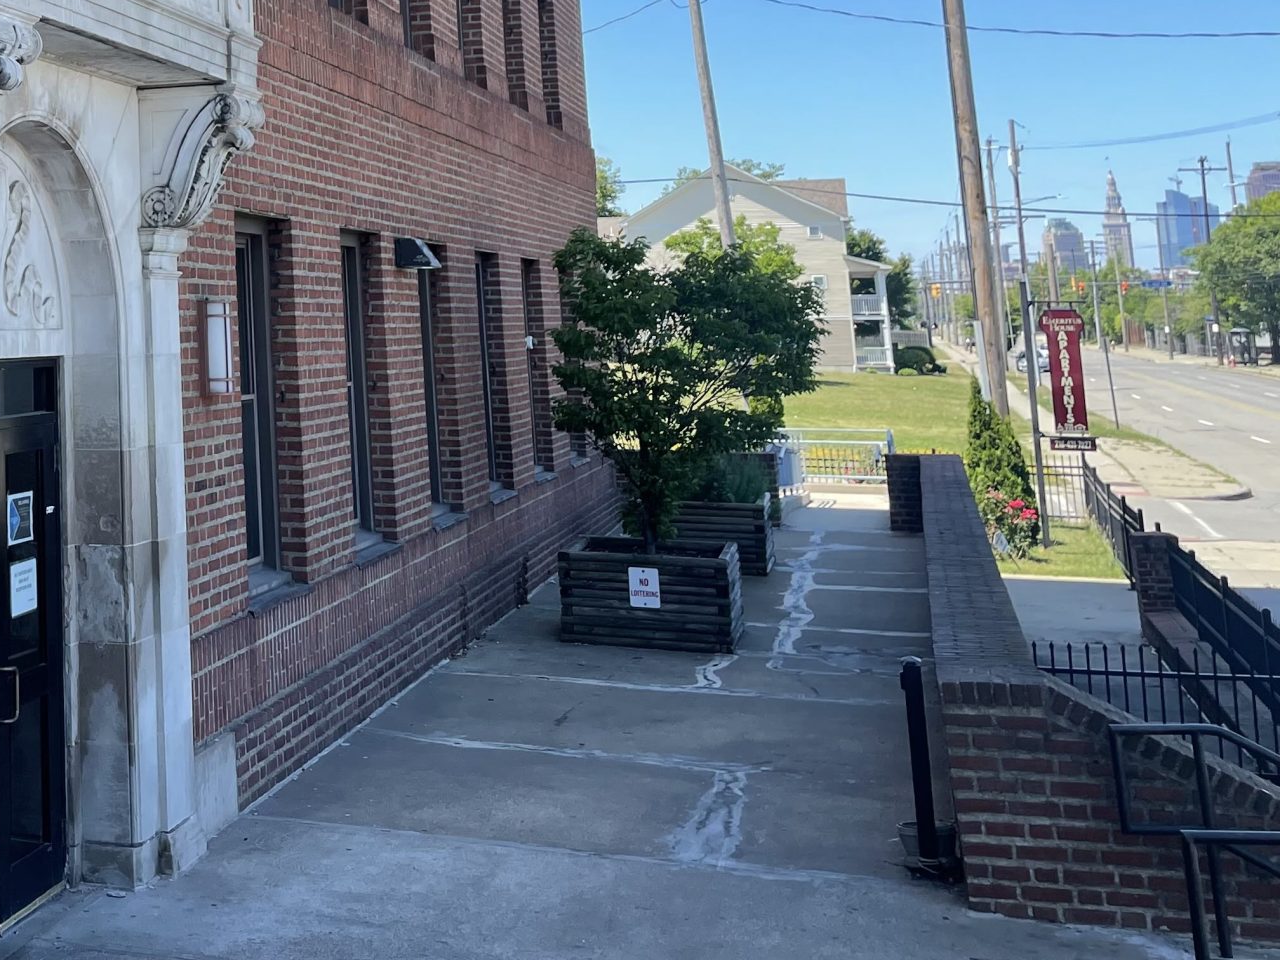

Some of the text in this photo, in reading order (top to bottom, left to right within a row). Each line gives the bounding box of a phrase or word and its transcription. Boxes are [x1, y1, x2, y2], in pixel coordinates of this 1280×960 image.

[1057, 331, 1075, 424] APARTMENTS
[639, 578, 649, 587] NO
[631, 590, 659, 598] LOITERING
